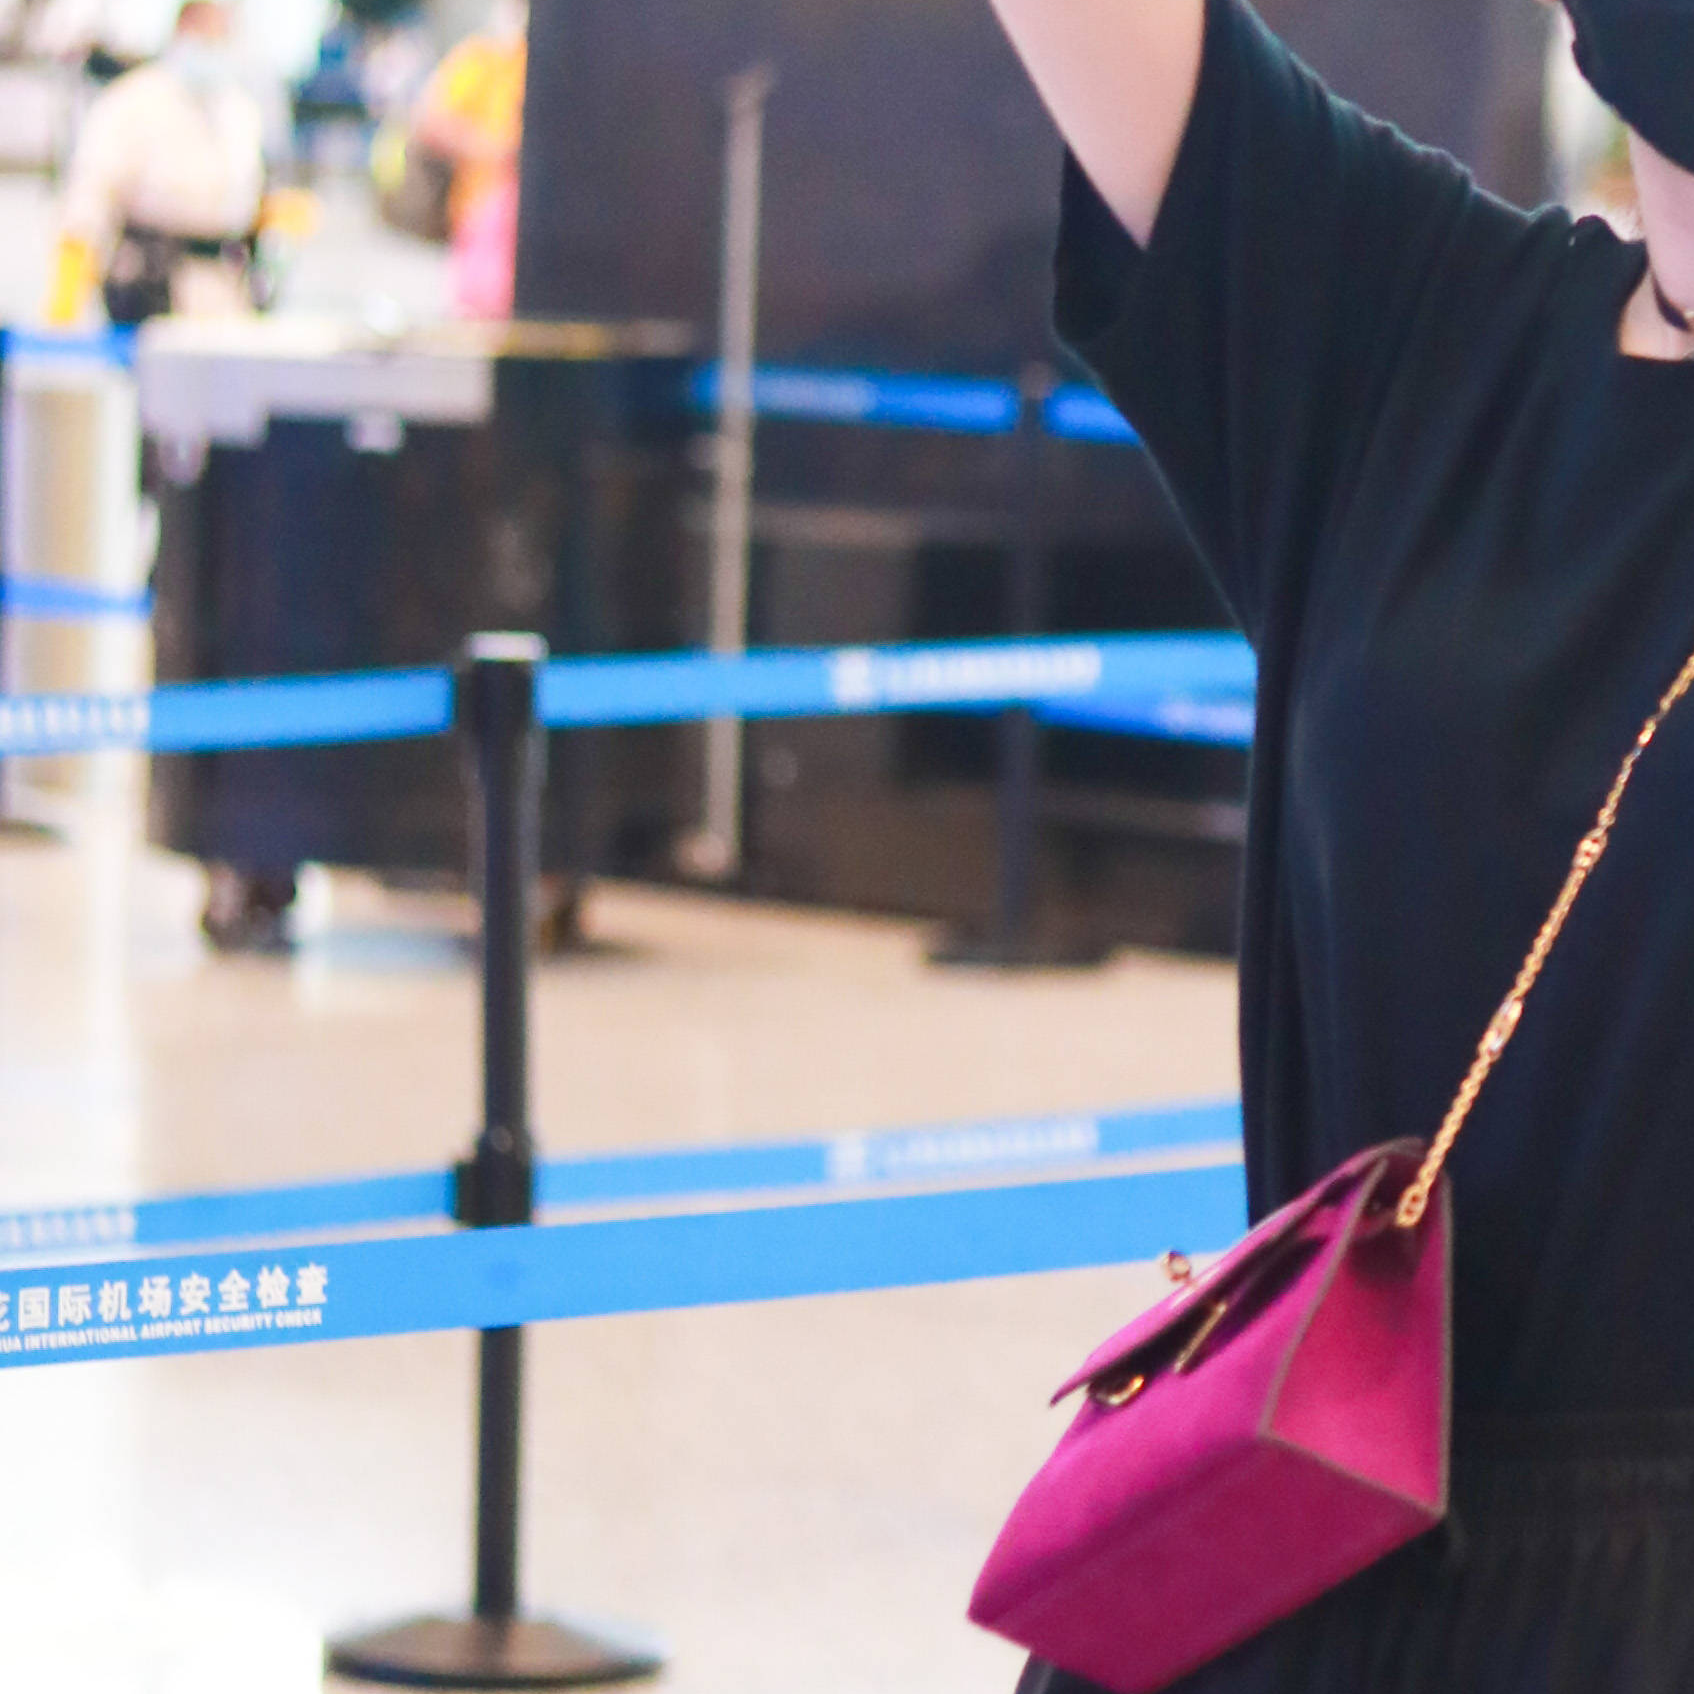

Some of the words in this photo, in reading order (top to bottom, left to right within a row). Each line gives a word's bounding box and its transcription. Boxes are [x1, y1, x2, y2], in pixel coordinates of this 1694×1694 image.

[0, 1262, 328, 1332] 国际机场安全检查
[24, 1325, 137, 1351] INTERNATIONAL
[141, 1318, 202, 1340] AIRPORT
[204, 1311, 273, 1335] SECURITY
[275, 1308, 322, 1329] CHECK
